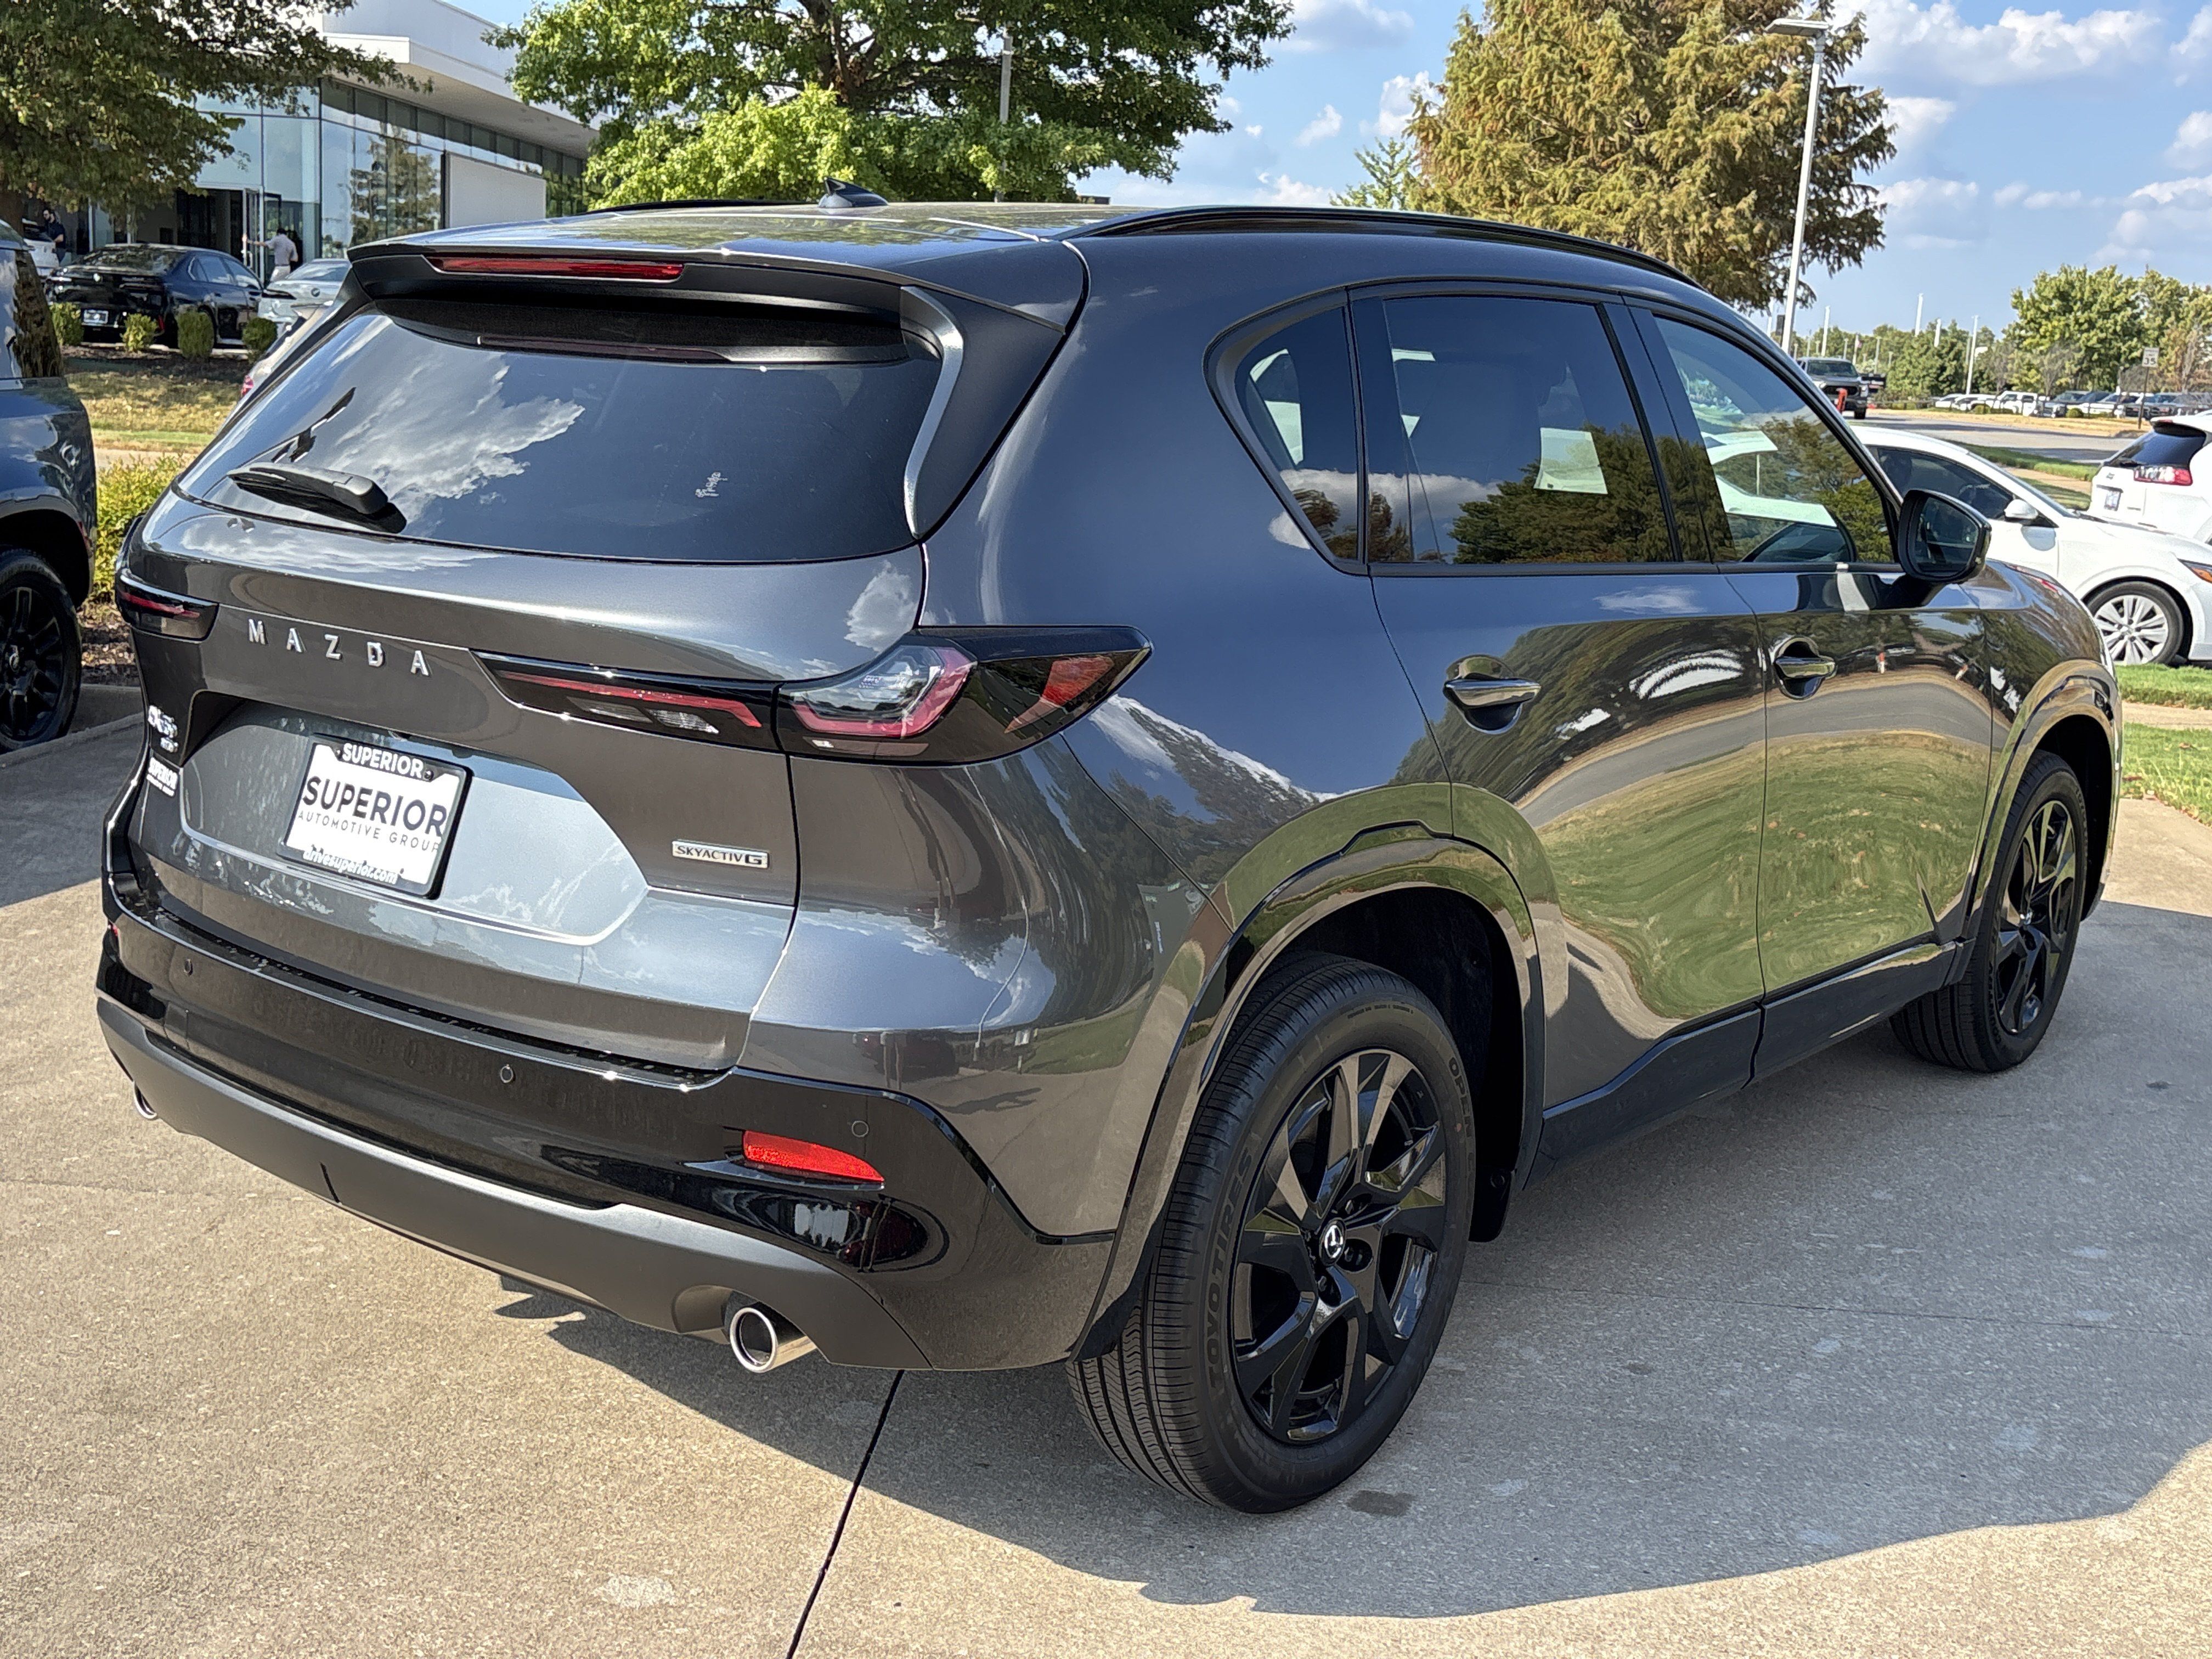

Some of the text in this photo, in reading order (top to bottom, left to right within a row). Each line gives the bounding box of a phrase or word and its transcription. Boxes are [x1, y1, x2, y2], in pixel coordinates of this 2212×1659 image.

[249, 619, 431, 676] MAZDA
[342, 743, 424, 778] SUPERIOR
[298, 810, 439, 853] AUTOMOTIVE GROUP
[302, 776, 447, 837] SUPERIOR
[303, 845, 399, 884] drivesuperior.com
[1448, 1057, 1472, 1138] OPEN
